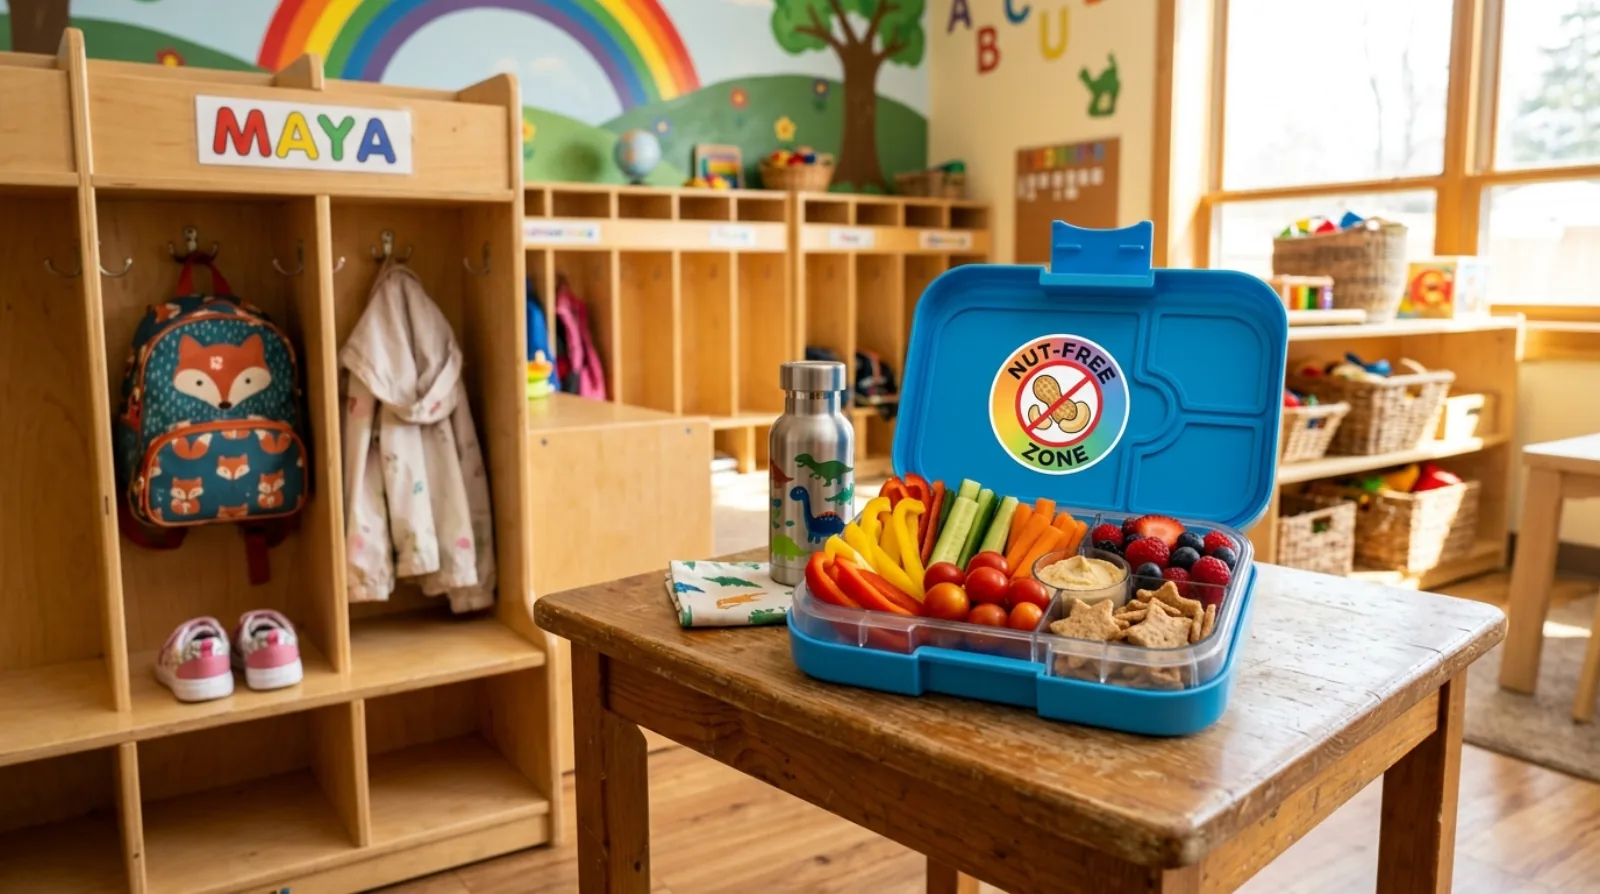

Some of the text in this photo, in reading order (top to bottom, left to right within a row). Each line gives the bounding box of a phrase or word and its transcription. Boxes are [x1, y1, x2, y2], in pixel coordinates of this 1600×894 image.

[947, 0, 972, 34] A
[1040, 6, 1069, 61] U
[977, 25, 1001, 75] B
[213, 106, 396, 164] MAYA
[1008, 342, 1116, 384] NUT-FREE
[1021, 442, 1089, 467] ZONE
